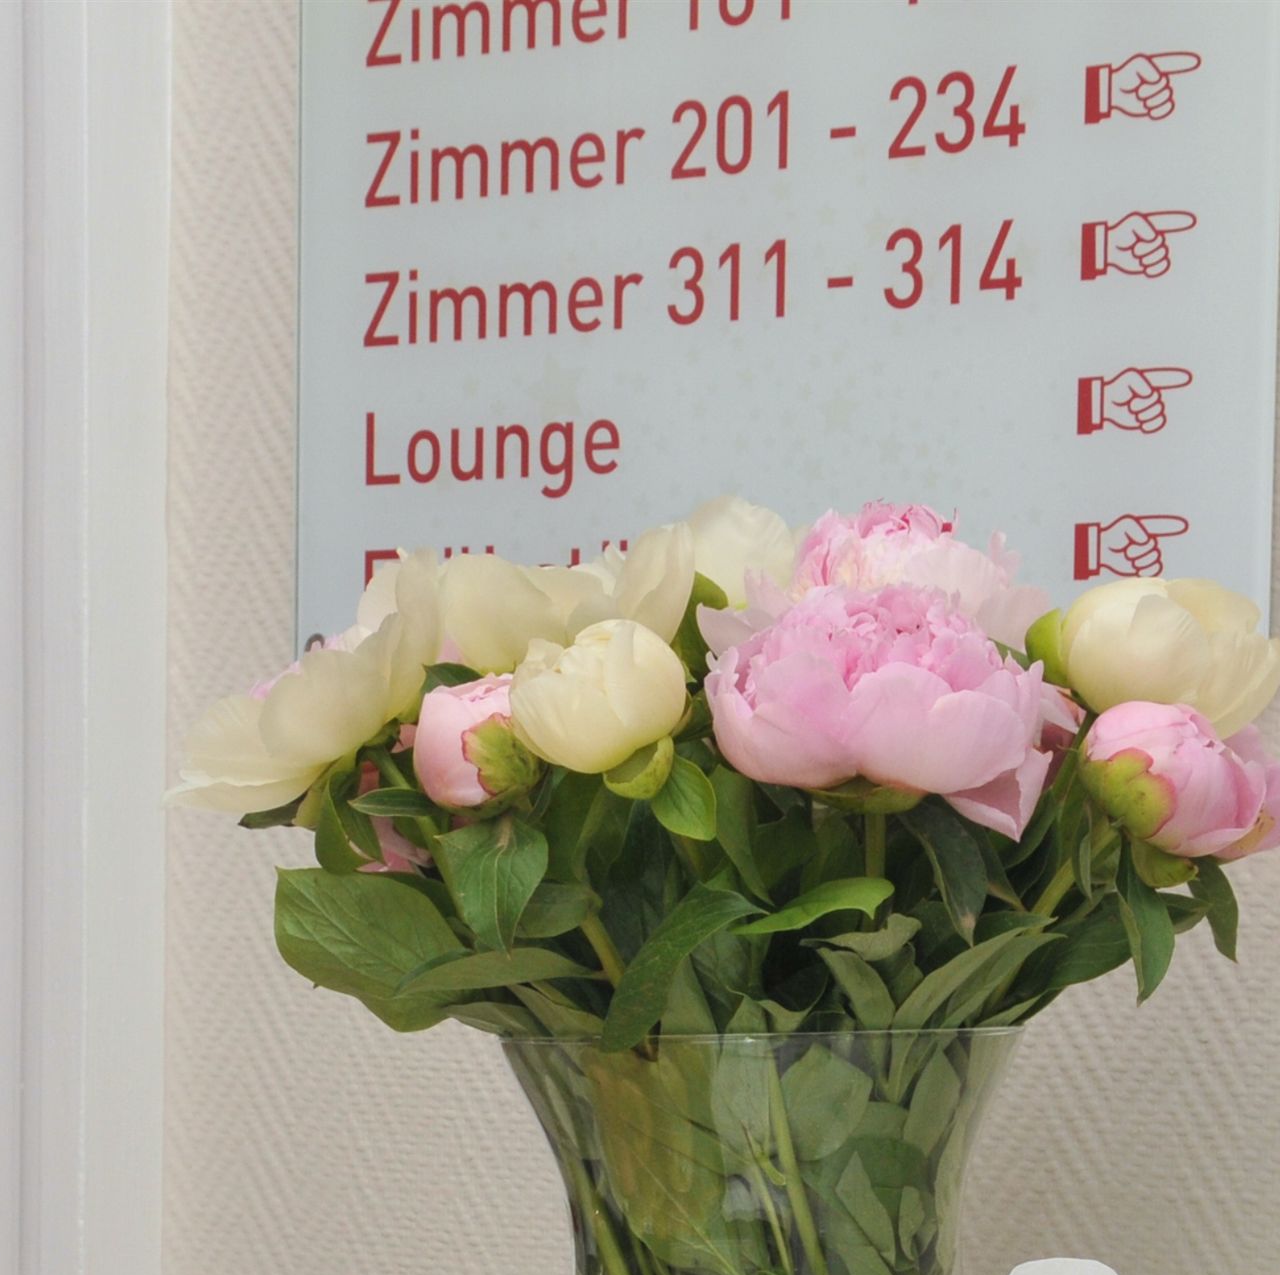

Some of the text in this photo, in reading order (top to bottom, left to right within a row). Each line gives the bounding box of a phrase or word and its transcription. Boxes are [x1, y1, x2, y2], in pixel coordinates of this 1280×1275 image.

[365, 65, 1027, 210] Zimmer 201 - 234
[363, 219, 1023, 348] Zimmer 311 - 314
[365, 412, 622, 499] Lounge
